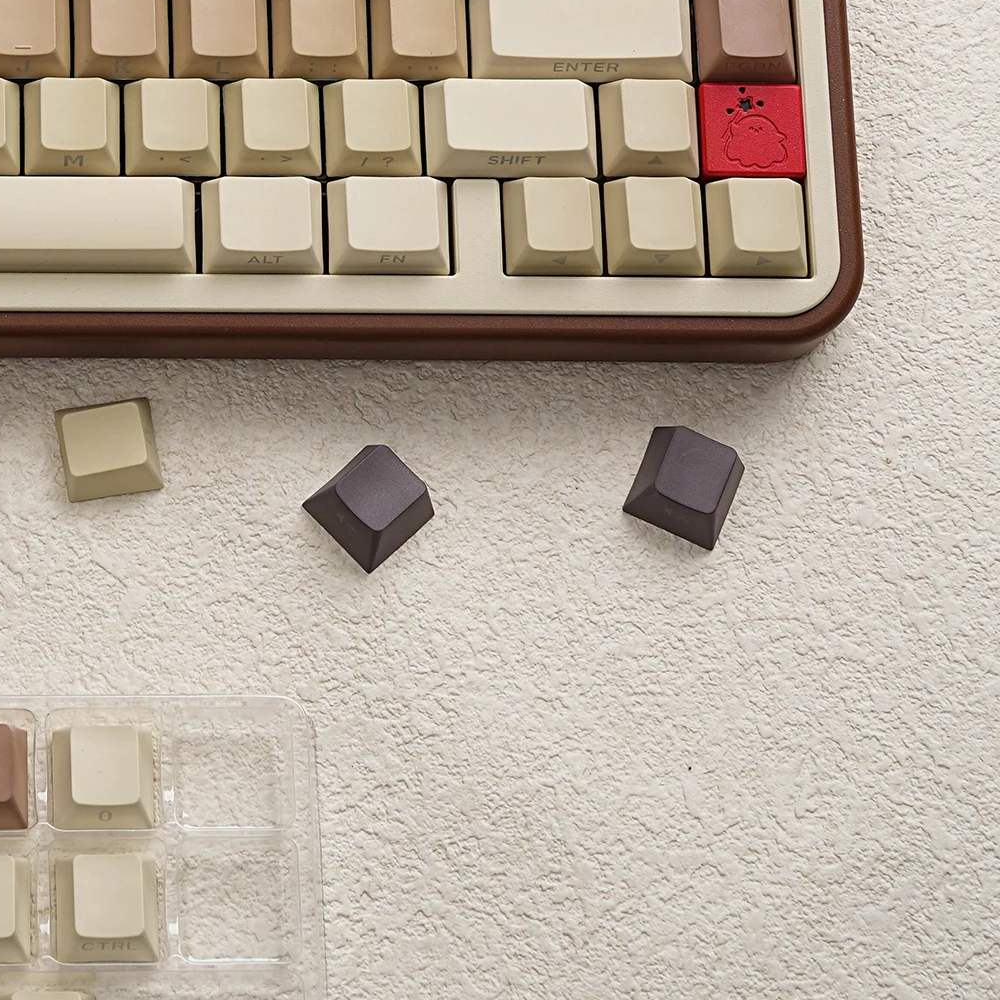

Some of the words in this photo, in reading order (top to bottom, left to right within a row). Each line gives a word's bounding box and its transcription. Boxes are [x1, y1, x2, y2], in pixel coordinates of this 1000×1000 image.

[16, 60, 31, 74] J
[113, 60, 132, 75] K
[215, 61, 230, 76] L
[552, 62, 620, 74] ENTER
[63, 154, 85, 168] M
[382, 155, 395, 169] ?
[487, 154, 546, 167] SHIFT
[246, 255, 285, 265] ALT
[379, 254, 407, 265] FN
[81, 940, 138, 952] CTRL
